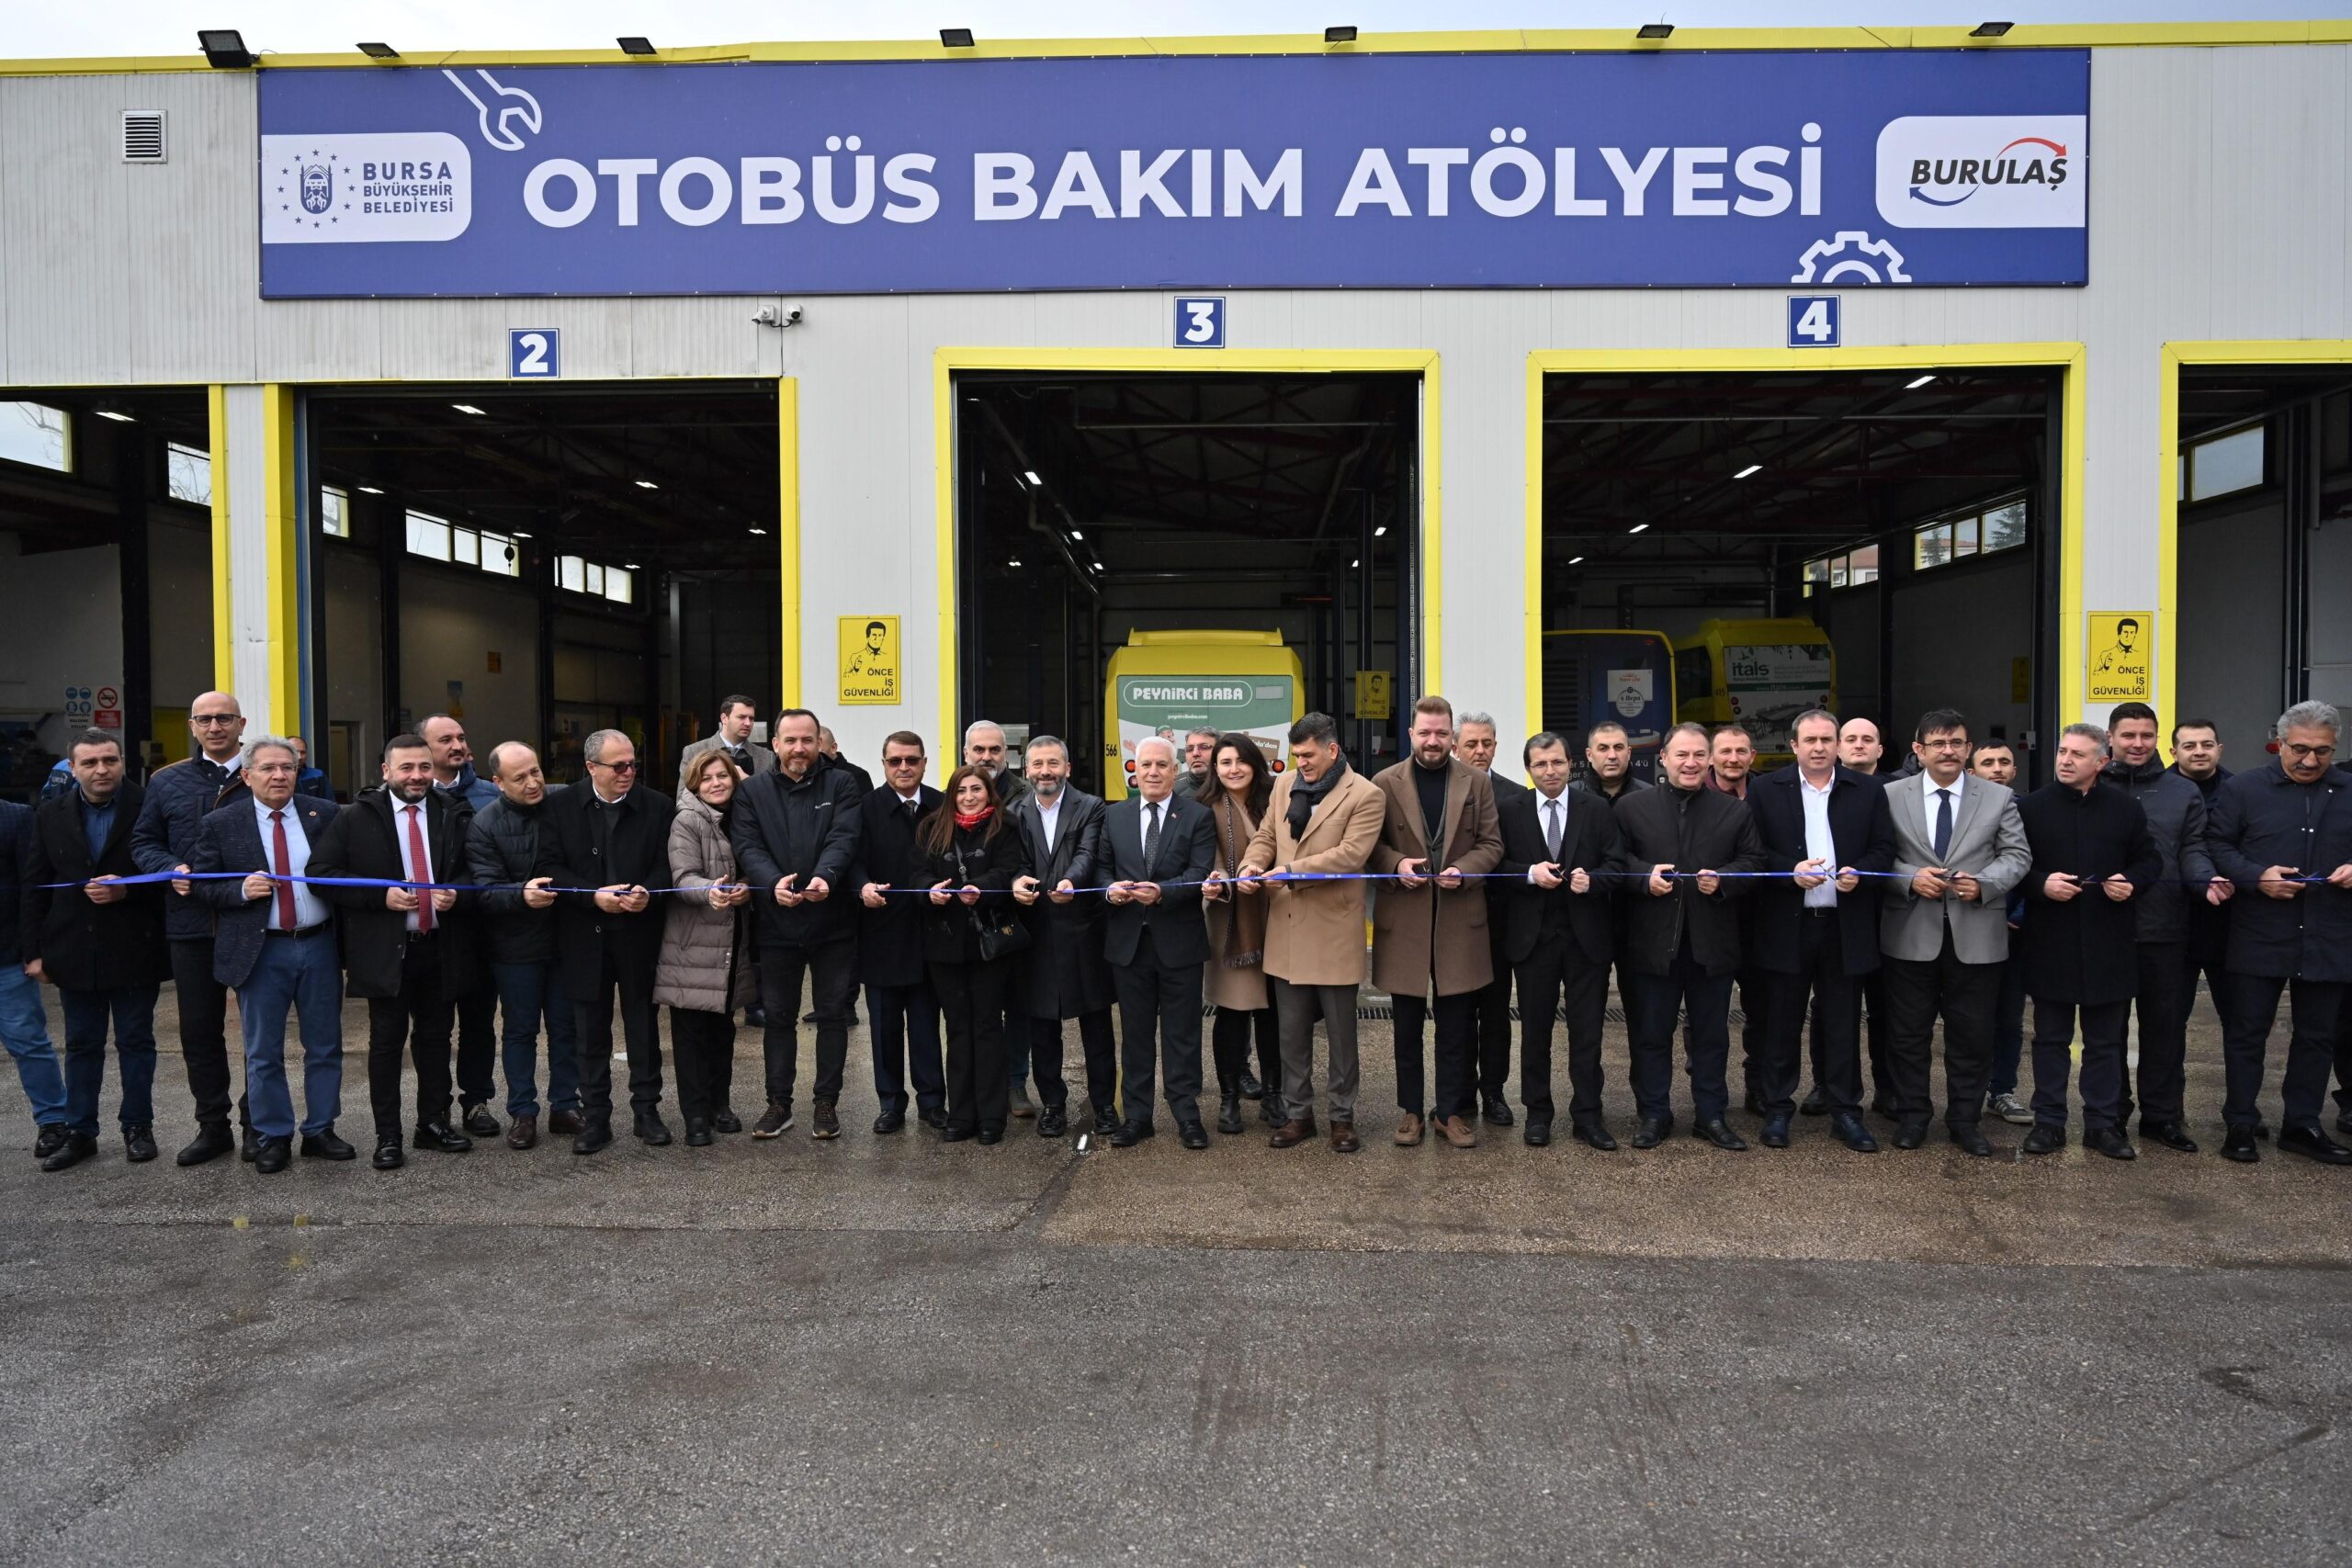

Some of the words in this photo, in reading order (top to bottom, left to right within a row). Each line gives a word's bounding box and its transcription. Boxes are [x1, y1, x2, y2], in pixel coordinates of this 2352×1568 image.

[363, 162, 452, 180] BURSA
[523, 135, 941, 228] OTOBÜS
[974, 149, 1304, 221] BAKIM
[1335, 122, 1822, 218] ATÖLYESİ
[1910, 158, 2068, 191] BURULAŞ
[363, 181, 452, 198] BÜYÜKŞEHİR
[363, 197, 453, 213] BELEDİYESİ
[1185, 302, 1216, 344] 3
[1796, 300, 1833, 343] 4
[520, 333, 549, 375] 2
[867, 667, 894, 676] ÖNCE
[1732, 661, 1770, 676] itals
[2118, 665, 2145, 674] ÖNCE
[885, 678, 894, 687] İŞ
[2136, 675, 2145, 686] İŞ
[843, 687, 894, 696] GÜVENLİĞİ
[1203, 687, 1244, 701] BABA
[2093, 685, 2145, 695] GÜVENLİĞİ
[1106, 743, 1118, 758] 566
